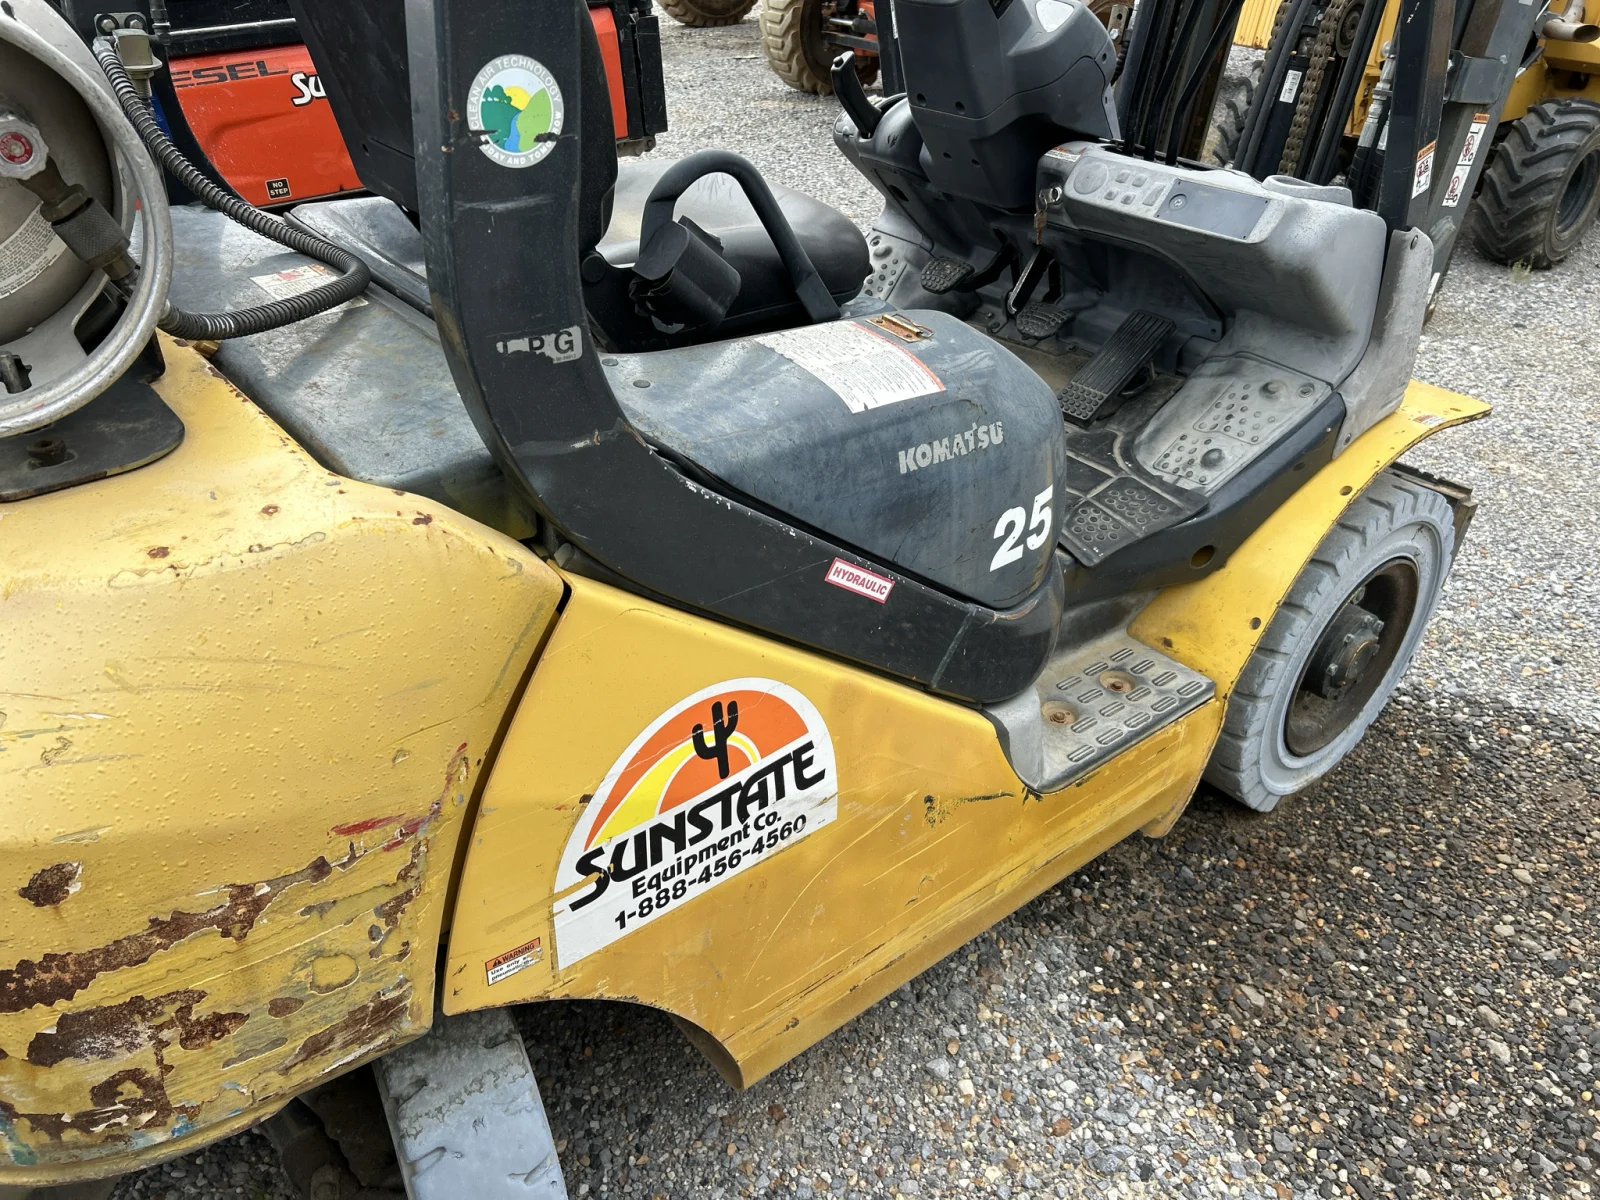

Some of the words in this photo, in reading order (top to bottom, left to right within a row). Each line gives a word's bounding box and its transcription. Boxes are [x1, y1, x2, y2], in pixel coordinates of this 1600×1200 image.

[469, 88, 482, 129] CLEAN
[478, 66, 495, 85] AIR
[495, 56, 561, 102] TECHNOLOGY
[507, 157, 526, 165] AND
[529, 111, 562, 161] TOMOROW
[270, 188, 288, 196] STEP
[898, 422, 1004, 474] KOMATSU
[989, 484, 1054, 573] 25
[832, 566, 888, 595] HYDRAULIC
[568, 740, 826, 912] SUNSTATE
[614, 814, 807, 930] 1-888-456-4560
[632, 823, 750, 899] Equipment
[753, 810, 782, 831] Co.
[491, 967, 503, 975] Use
[506, 959, 520, 968] only
[491, 963, 522, 981] pneumatic
[502, 943, 535, 962] WARNING
